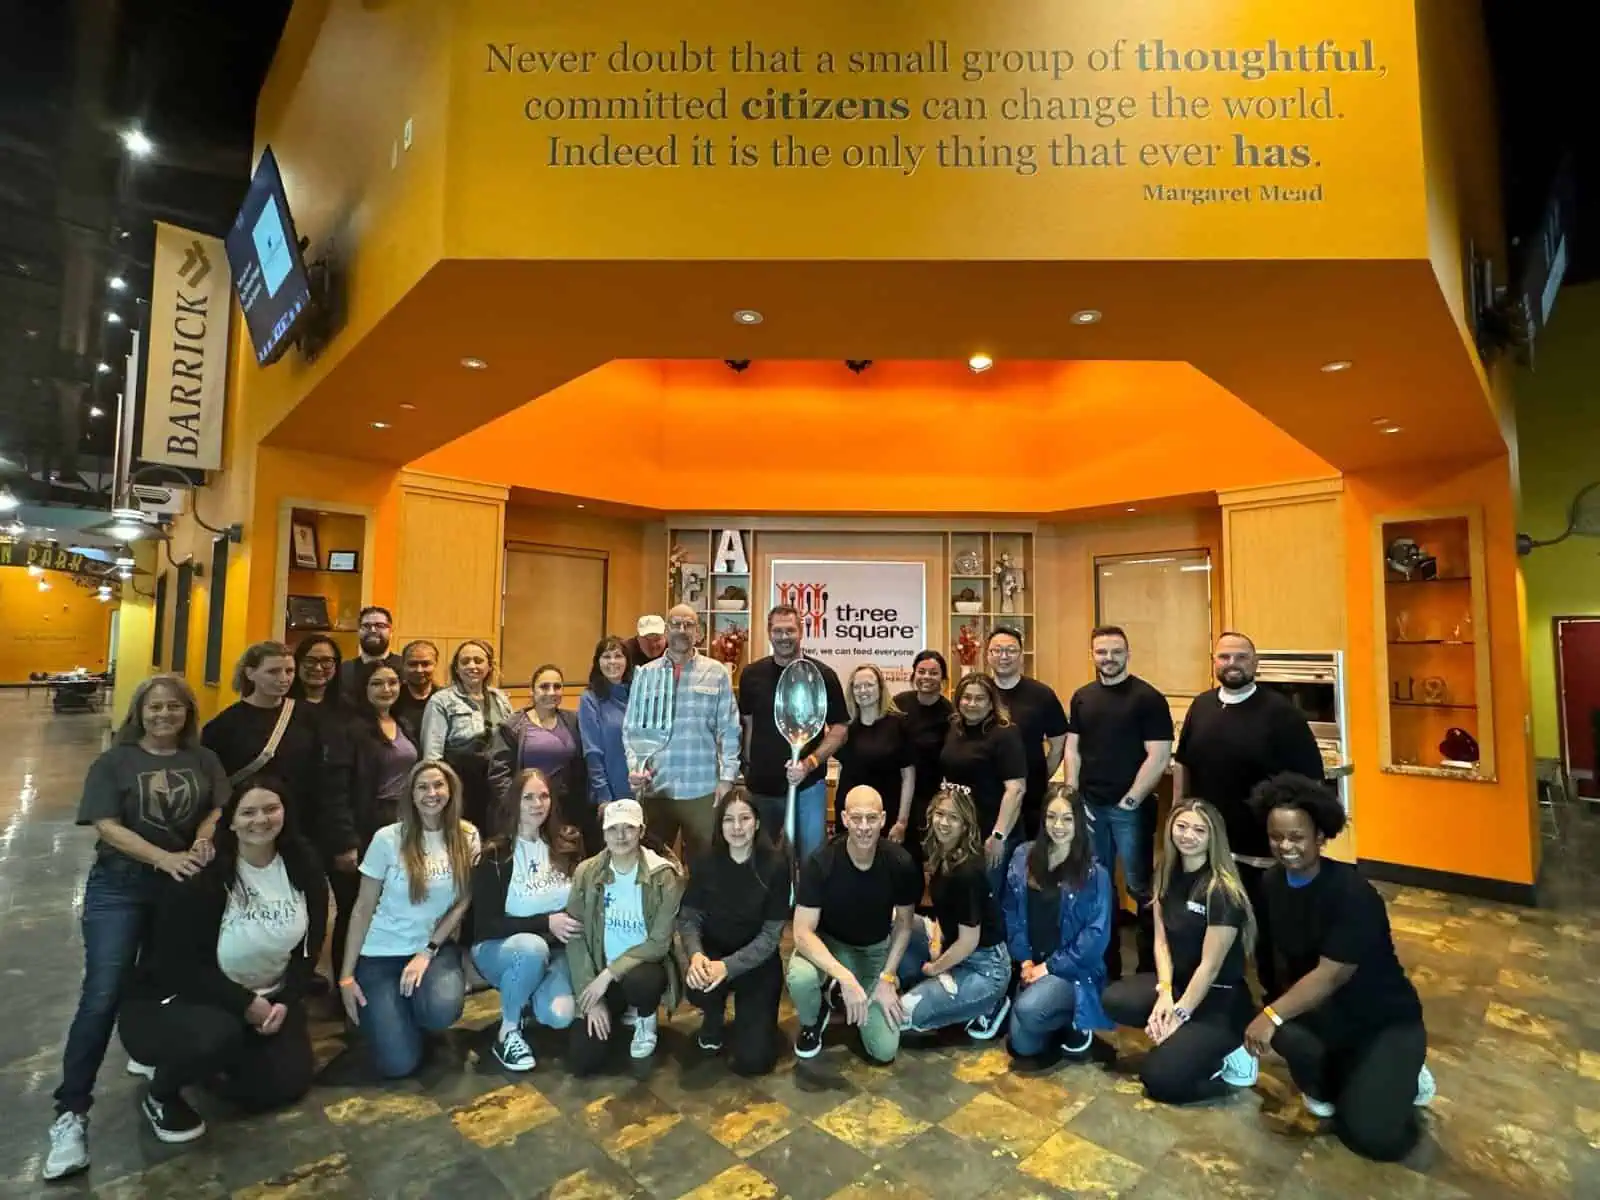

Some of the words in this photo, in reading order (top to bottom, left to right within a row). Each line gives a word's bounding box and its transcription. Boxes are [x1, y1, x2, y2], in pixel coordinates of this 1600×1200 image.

[486, 42, 599, 74] Never
[608, 40, 716, 73] doubt
[729, 42, 803, 73] that
[816, 49, 835, 73] a
[848, 40, 950, 73] small
[961, 45, 1074, 80] group
[1087, 39, 1127, 72] of
[1135, 39, 1388, 80] thoughtful,
[524, 88, 729, 121] committed
[741, 88, 911, 121] citizens
[921, 96, 987, 120] can
[1000, 87, 1137, 127] change
[1150, 86, 1210, 120] the
[1221, 87, 1345, 120] world.
[547, 135, 680, 168] Indeed
[691, 136, 716, 168] it
[728, 136, 760, 168] is
[771, 135, 832, 168] the
[842, 135, 925, 176] only
[936, 135, 1037, 175] thing
[1047, 134, 1128, 168] that
[1138, 142, 1223, 168] ever
[1232, 134, 1322, 168] has.
[1142, 183, 1252, 205] Margaret
[1259, 183, 1324, 202] Mead
[166, 290, 209, 460] BARRICK
[835, 603, 898, 622] three
[835, 624, 914, 642] square
[834, 647, 851, 655] can
[853, 647, 873, 656] feed
[874, 648, 915, 657] everyone
